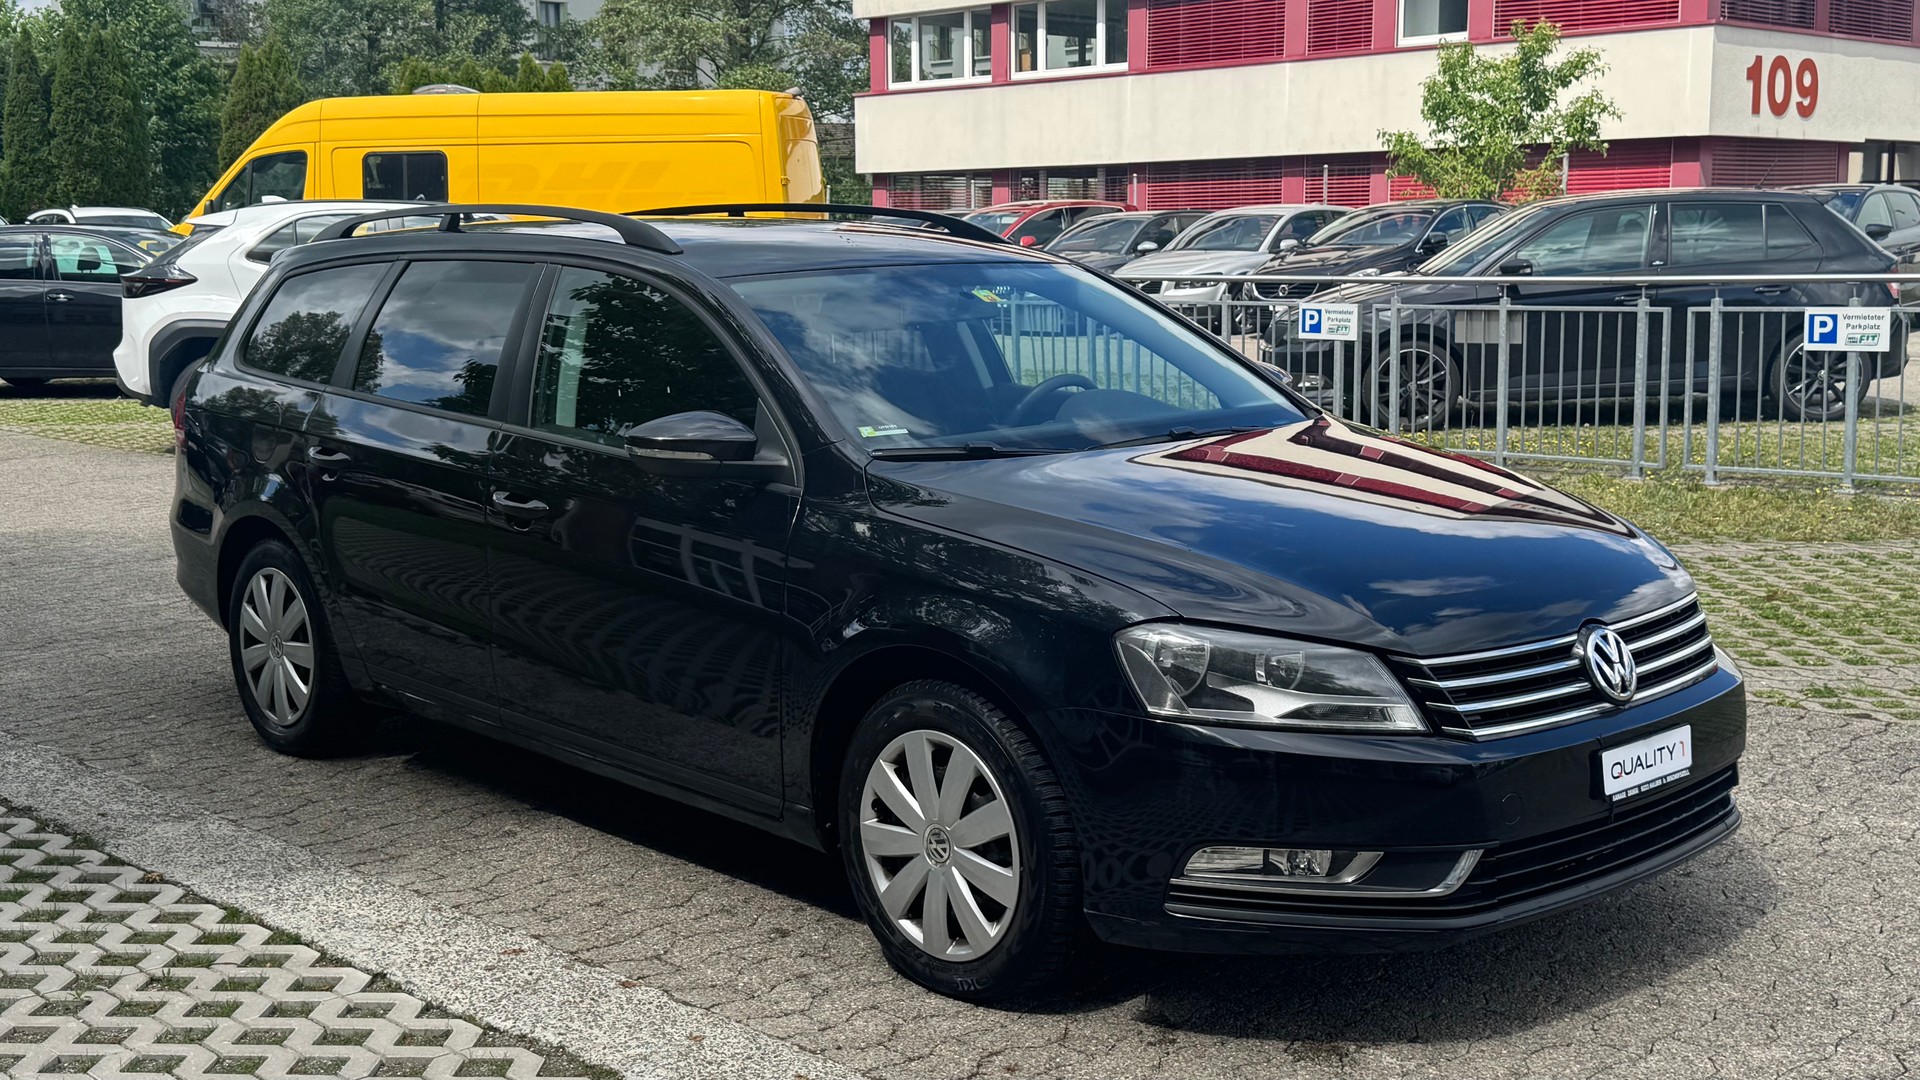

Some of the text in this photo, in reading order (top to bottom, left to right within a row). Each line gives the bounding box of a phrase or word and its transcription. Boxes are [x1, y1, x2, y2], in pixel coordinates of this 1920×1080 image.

[1746, 54, 1819, 119] 109
[1305, 309, 1319, 332] P
[1813, 315, 1834, 342] P
[1846, 323, 1881, 331] Parkplatz
[1859, 335, 1877, 343] FIT
[1611, 740, 1685, 779] QUALITY 1
